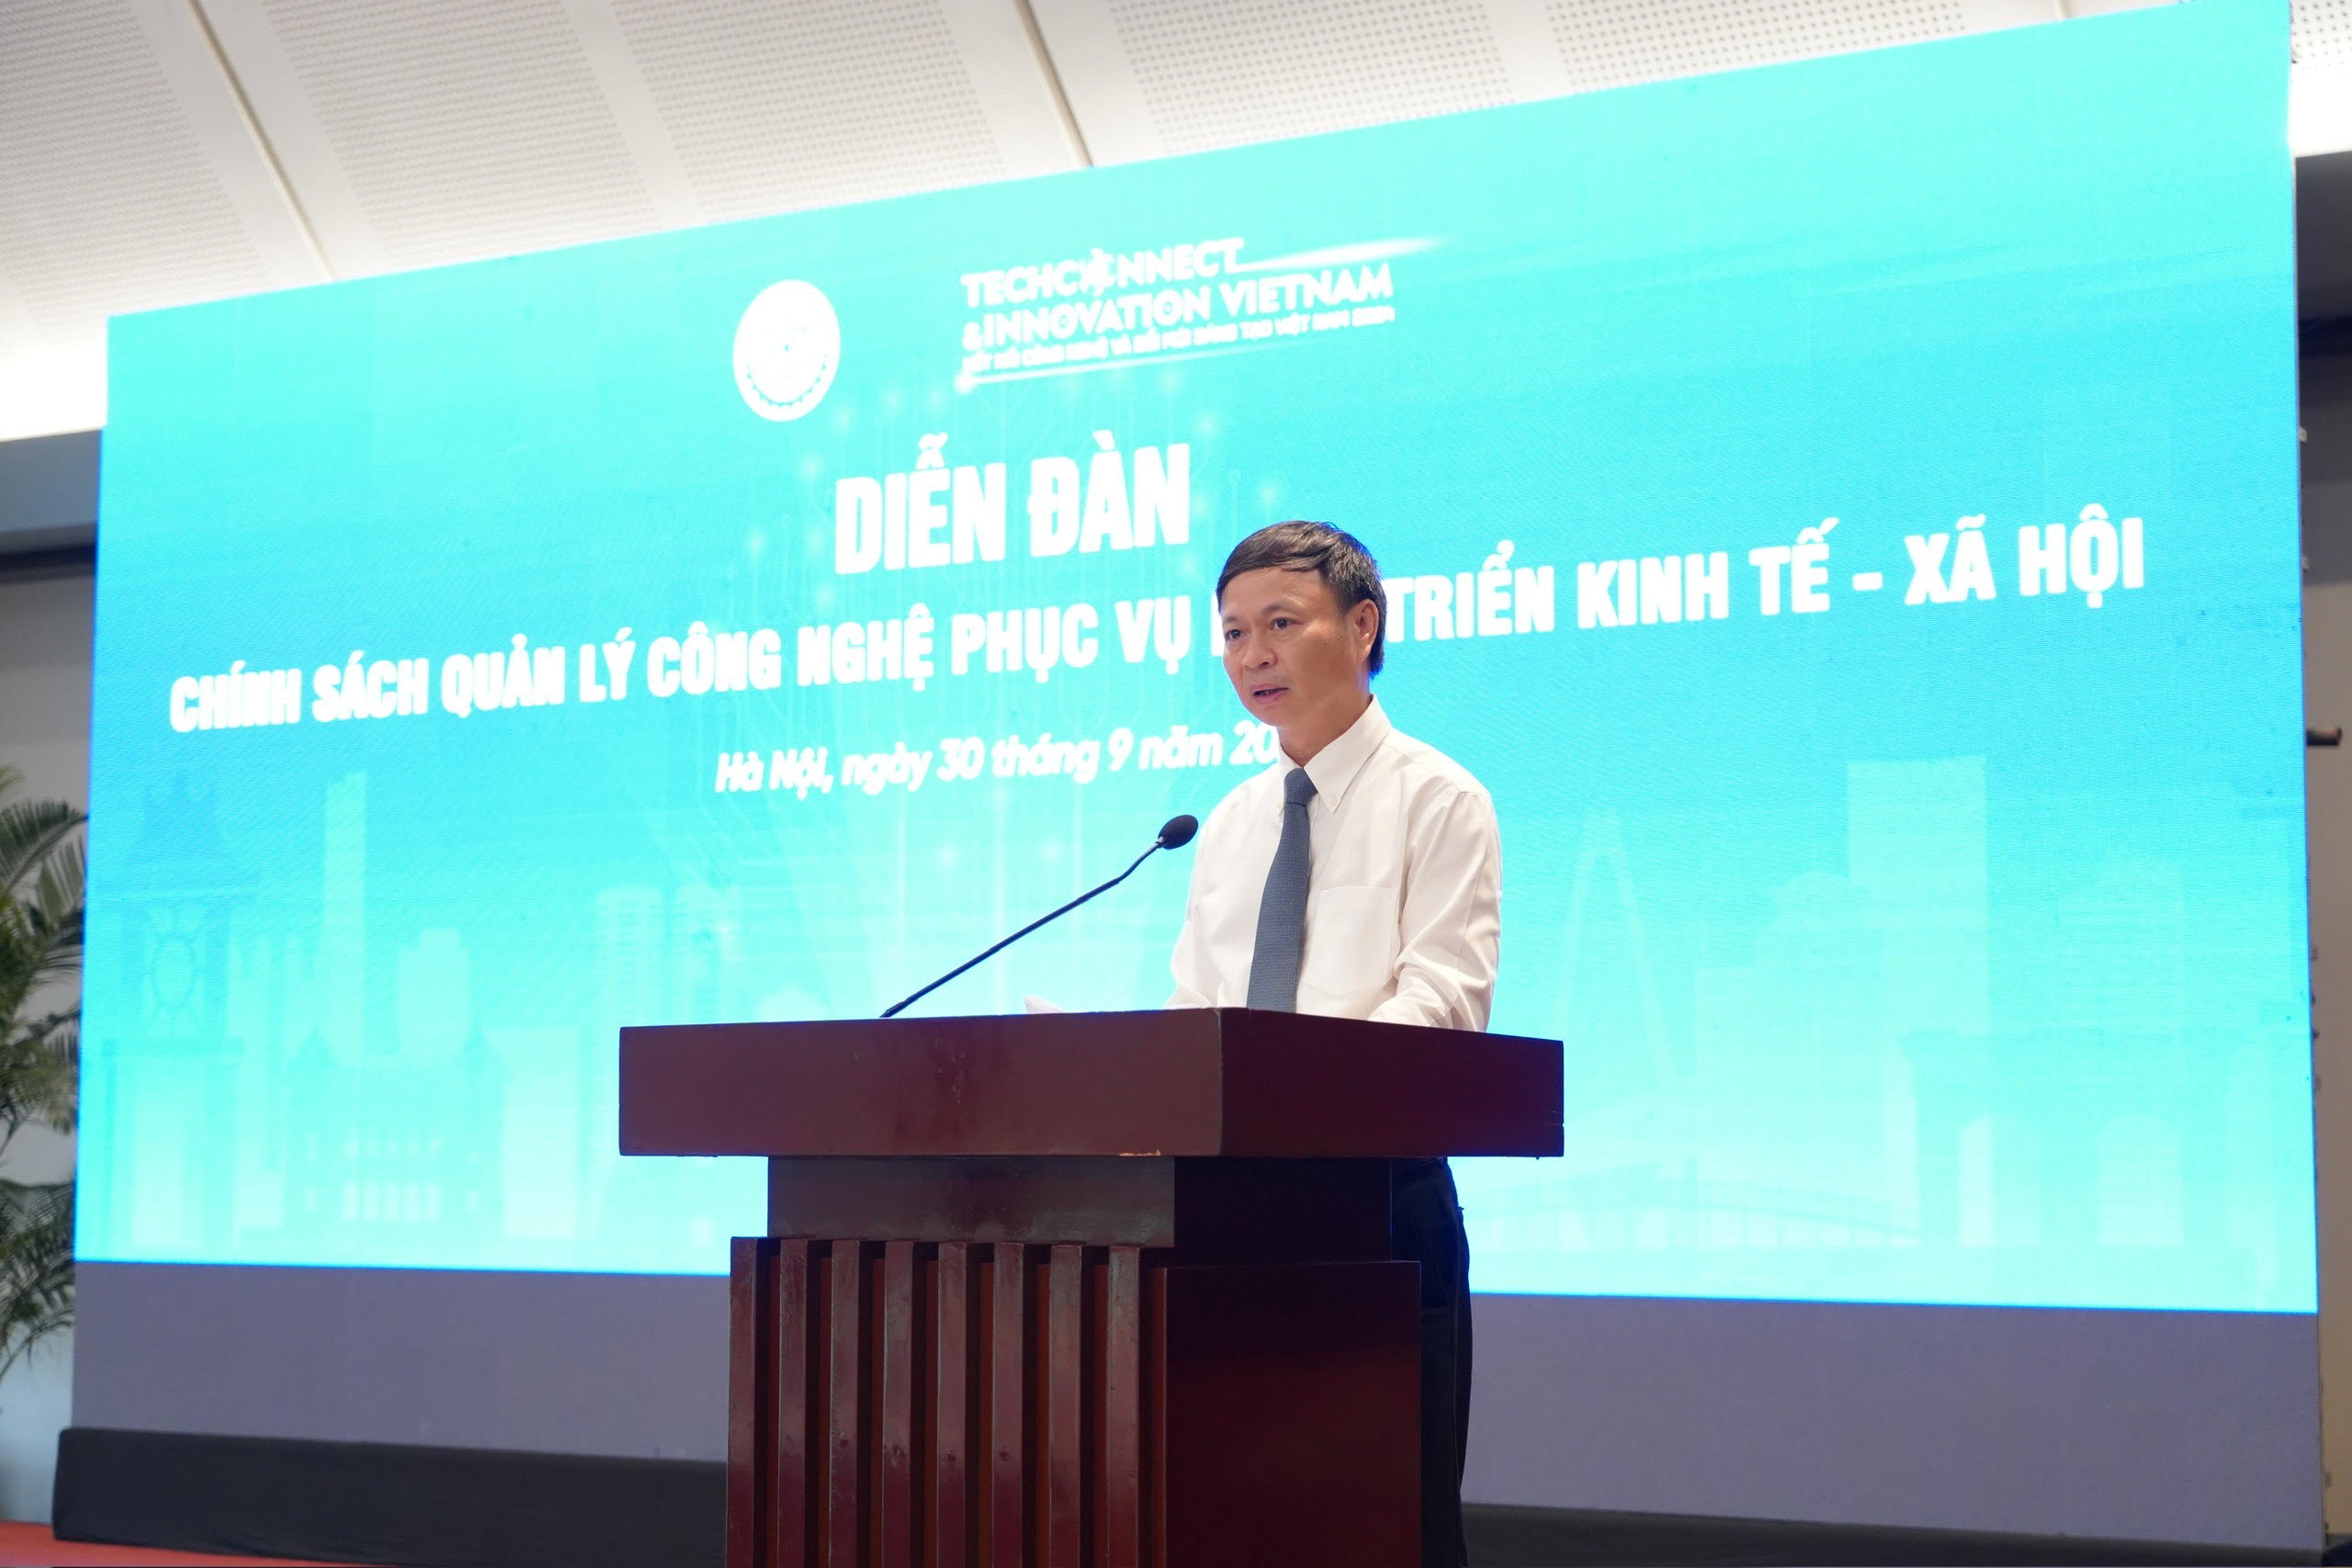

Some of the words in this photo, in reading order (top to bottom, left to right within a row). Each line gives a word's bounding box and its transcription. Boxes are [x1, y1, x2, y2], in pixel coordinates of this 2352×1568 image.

[1219, 263, 1394, 316] VIETNAM
[835, 432, 1006, 574] DIỄN
[1027, 430, 1190, 557] ĐÀN
[171, 660, 301, 732] CHÍNH
[312, 650, 429, 722] SÁCH
[441, 634, 565, 717] QUẢN
[580, 627, 636, 702] LÝ
[648, 621, 781, 697] CÔNG
[797, 603, 934, 692] NGHỆ
[951, 603, 1099, 683] PHỤC
[1114, 595, 1191, 674] VỤ
[1382, 540, 1555, 642] TRIỂN
[1577, 552, 1728, 628] KINH
[1749, 518, 1838, 615] TẾ
[1905, 514, 1996, 604] XÃ
[2019, 503, 2143, 608] HỘI
[716, 751, 764, 792] Hà
[769, 747, 834, 800] Nội,
[841, 741, 933, 795] ngày
[936, 736, 986, 782] 30
[991, 733, 1101, 784] tháng
[1108, 728, 1134, 772] 9
[1138, 725, 1224, 770] năm
